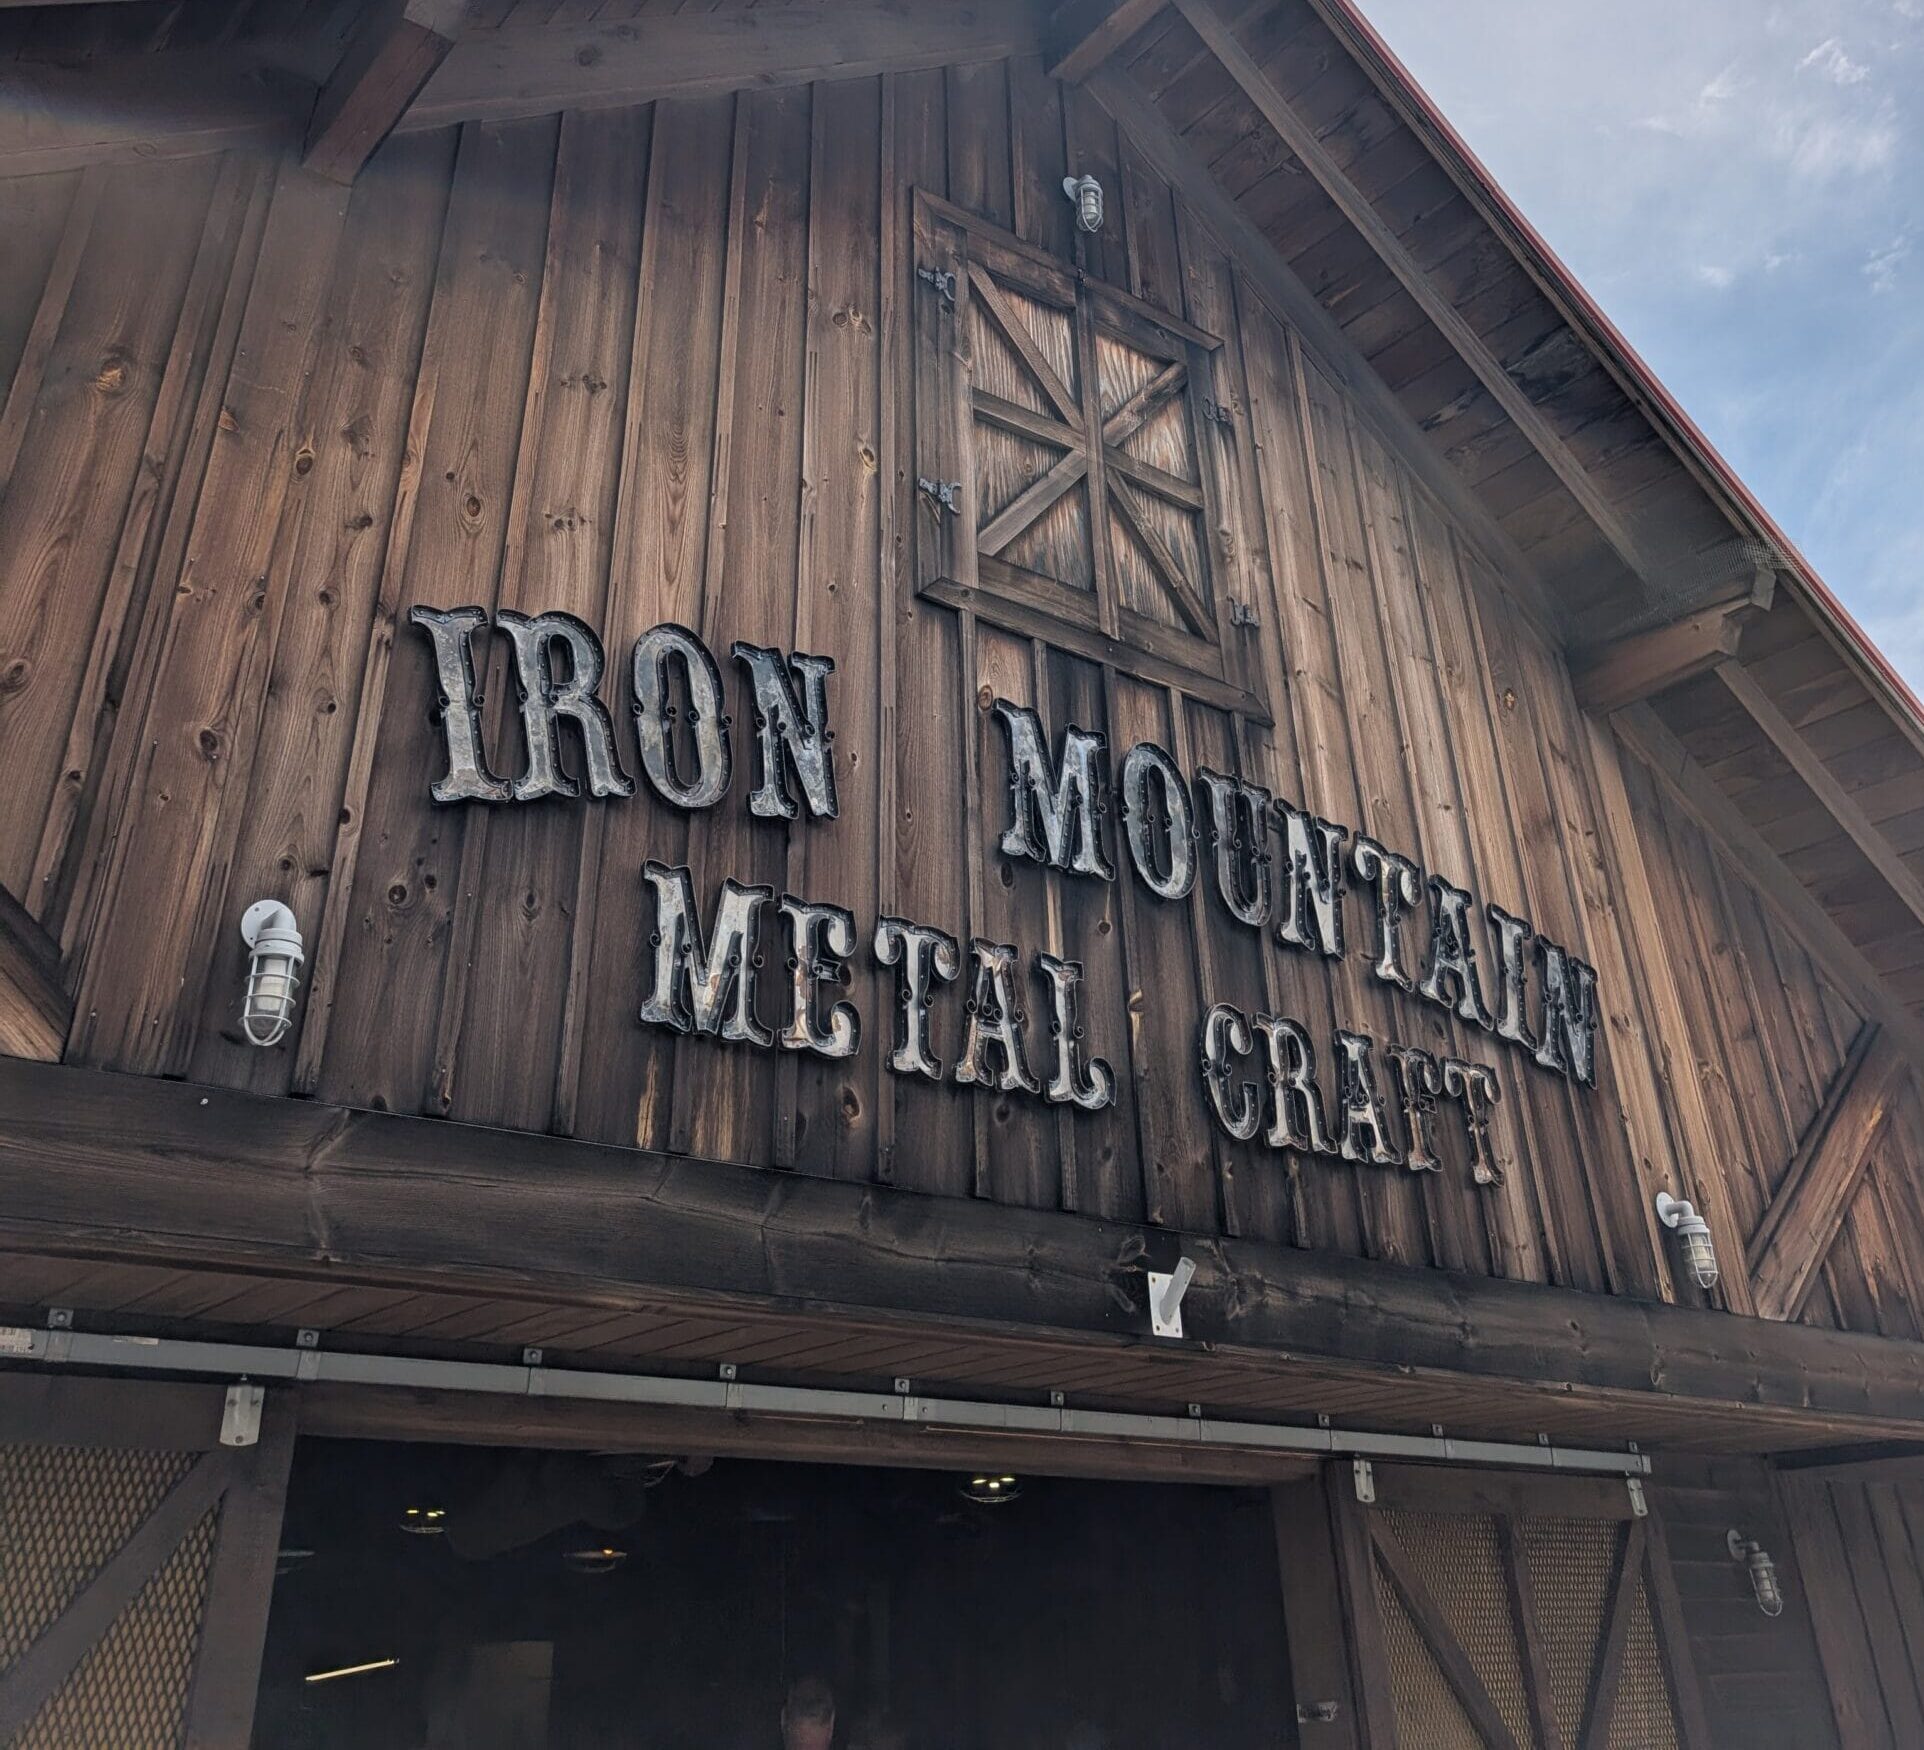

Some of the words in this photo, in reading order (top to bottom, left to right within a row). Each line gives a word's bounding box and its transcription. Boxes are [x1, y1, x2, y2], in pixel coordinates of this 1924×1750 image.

[409, 604, 839, 820] IRON
[993, 697, 1598, 1090] MOUNTAIN
[640, 858, 1116, 1110] METAL
[1201, 1002, 1504, 1187] CRAFT
